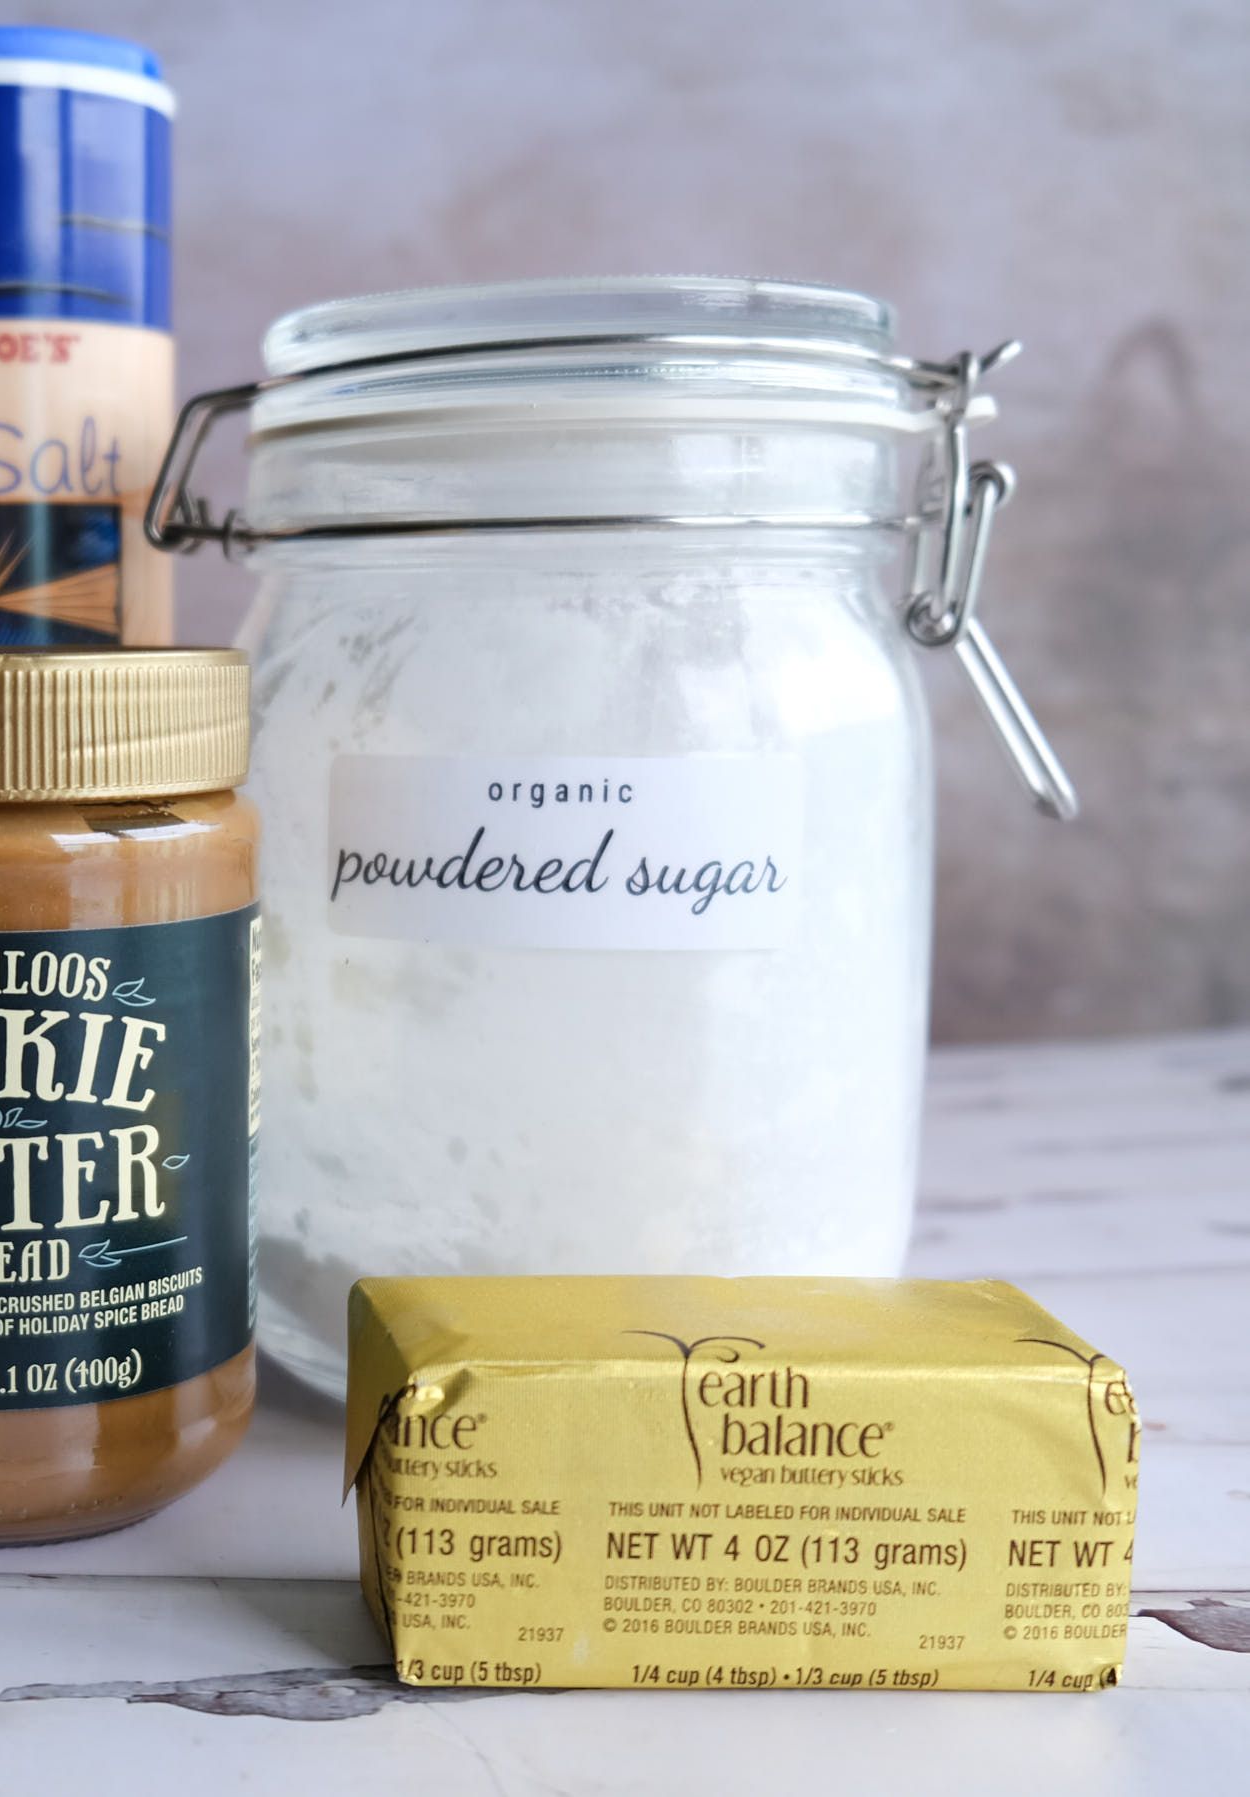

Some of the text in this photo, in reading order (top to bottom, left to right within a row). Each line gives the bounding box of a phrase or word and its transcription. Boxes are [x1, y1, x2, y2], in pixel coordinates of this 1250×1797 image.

[488, 778, 633, 808] organic
[331, 826, 787, 915] powdered sugar
[80, 1282, 145, 1308] BELGIAN
[149, 1266, 203, 1296] BISCUITS
[19, 1313, 90, 1336] HOLIDAY
[94, 1306, 137, 1329] SPICE
[141, 1295, 184, 1321] BREAD
[27, 1363, 58, 1392] OZ
[65, 1348, 142, 1394] (400g)
[698, 1366, 809, 1409] earth
[446, 1459, 498, 1479] sticks
[720, 1464, 904, 1488] vegan buttery sticks
[393, 1497, 424, 1513] FOR
[430, 1499, 516, 1515] INDIVIDUAL
[521, 1500, 560, 1515] SALE
[609, 1501, 966, 1523] THIS UNIT NOT LABELED FOR INDIVIDUAL SALE
[1012, 1509, 1046, 1524] THIS
[1051, 1510, 1087, 1525] UNIT
[1093, 1511, 1121, 1526] NOT
[396, 1526, 454, 1560] (113
[470, 1530, 562, 1564] grams)
[606, 1532, 967, 1572] NET WT 4 OZ (113 grams)
[1008, 1539, 1115, 1568] NET WT
[406, 1570, 466, 1588] BRANDS
[471, 1572, 505, 1589] USA,
[510, 1574, 541, 1589] INC.
[604, 1575, 941, 1597] DISTRIBUTED BY: BOULDER BRANDS USA, INC.
[1006, 1582, 1128, 1598] DISTRIBUTED BY:
[603, 1597, 877, 1616] BOULDER, CO 80302 201-421-3970
[1004, 1603, 1100, 1620] BOULDER, CO
[402, 1613, 436, 1630] USA,
[441, 1614, 471, 1630] INC.
[622, 1618, 871, 1638] 2016 BOULDER BRANDS USA, INC.
[1022, 1624, 1126, 1640] 2016 BOULDER
[518, 1626, 564, 1642] 21937
[919, 1635, 965, 1650] 21937
[431, 1663, 464, 1683] cup
[471, 1661, 488, 1683] (5
[494, 1661, 542, 1685] tbsp)
[632, 1664, 939, 1688] 1/4 cup (4 tbsp) 1/3 cup (5 tbsp)
[1028, 1667, 1117, 1691] 1/4 cup (4
